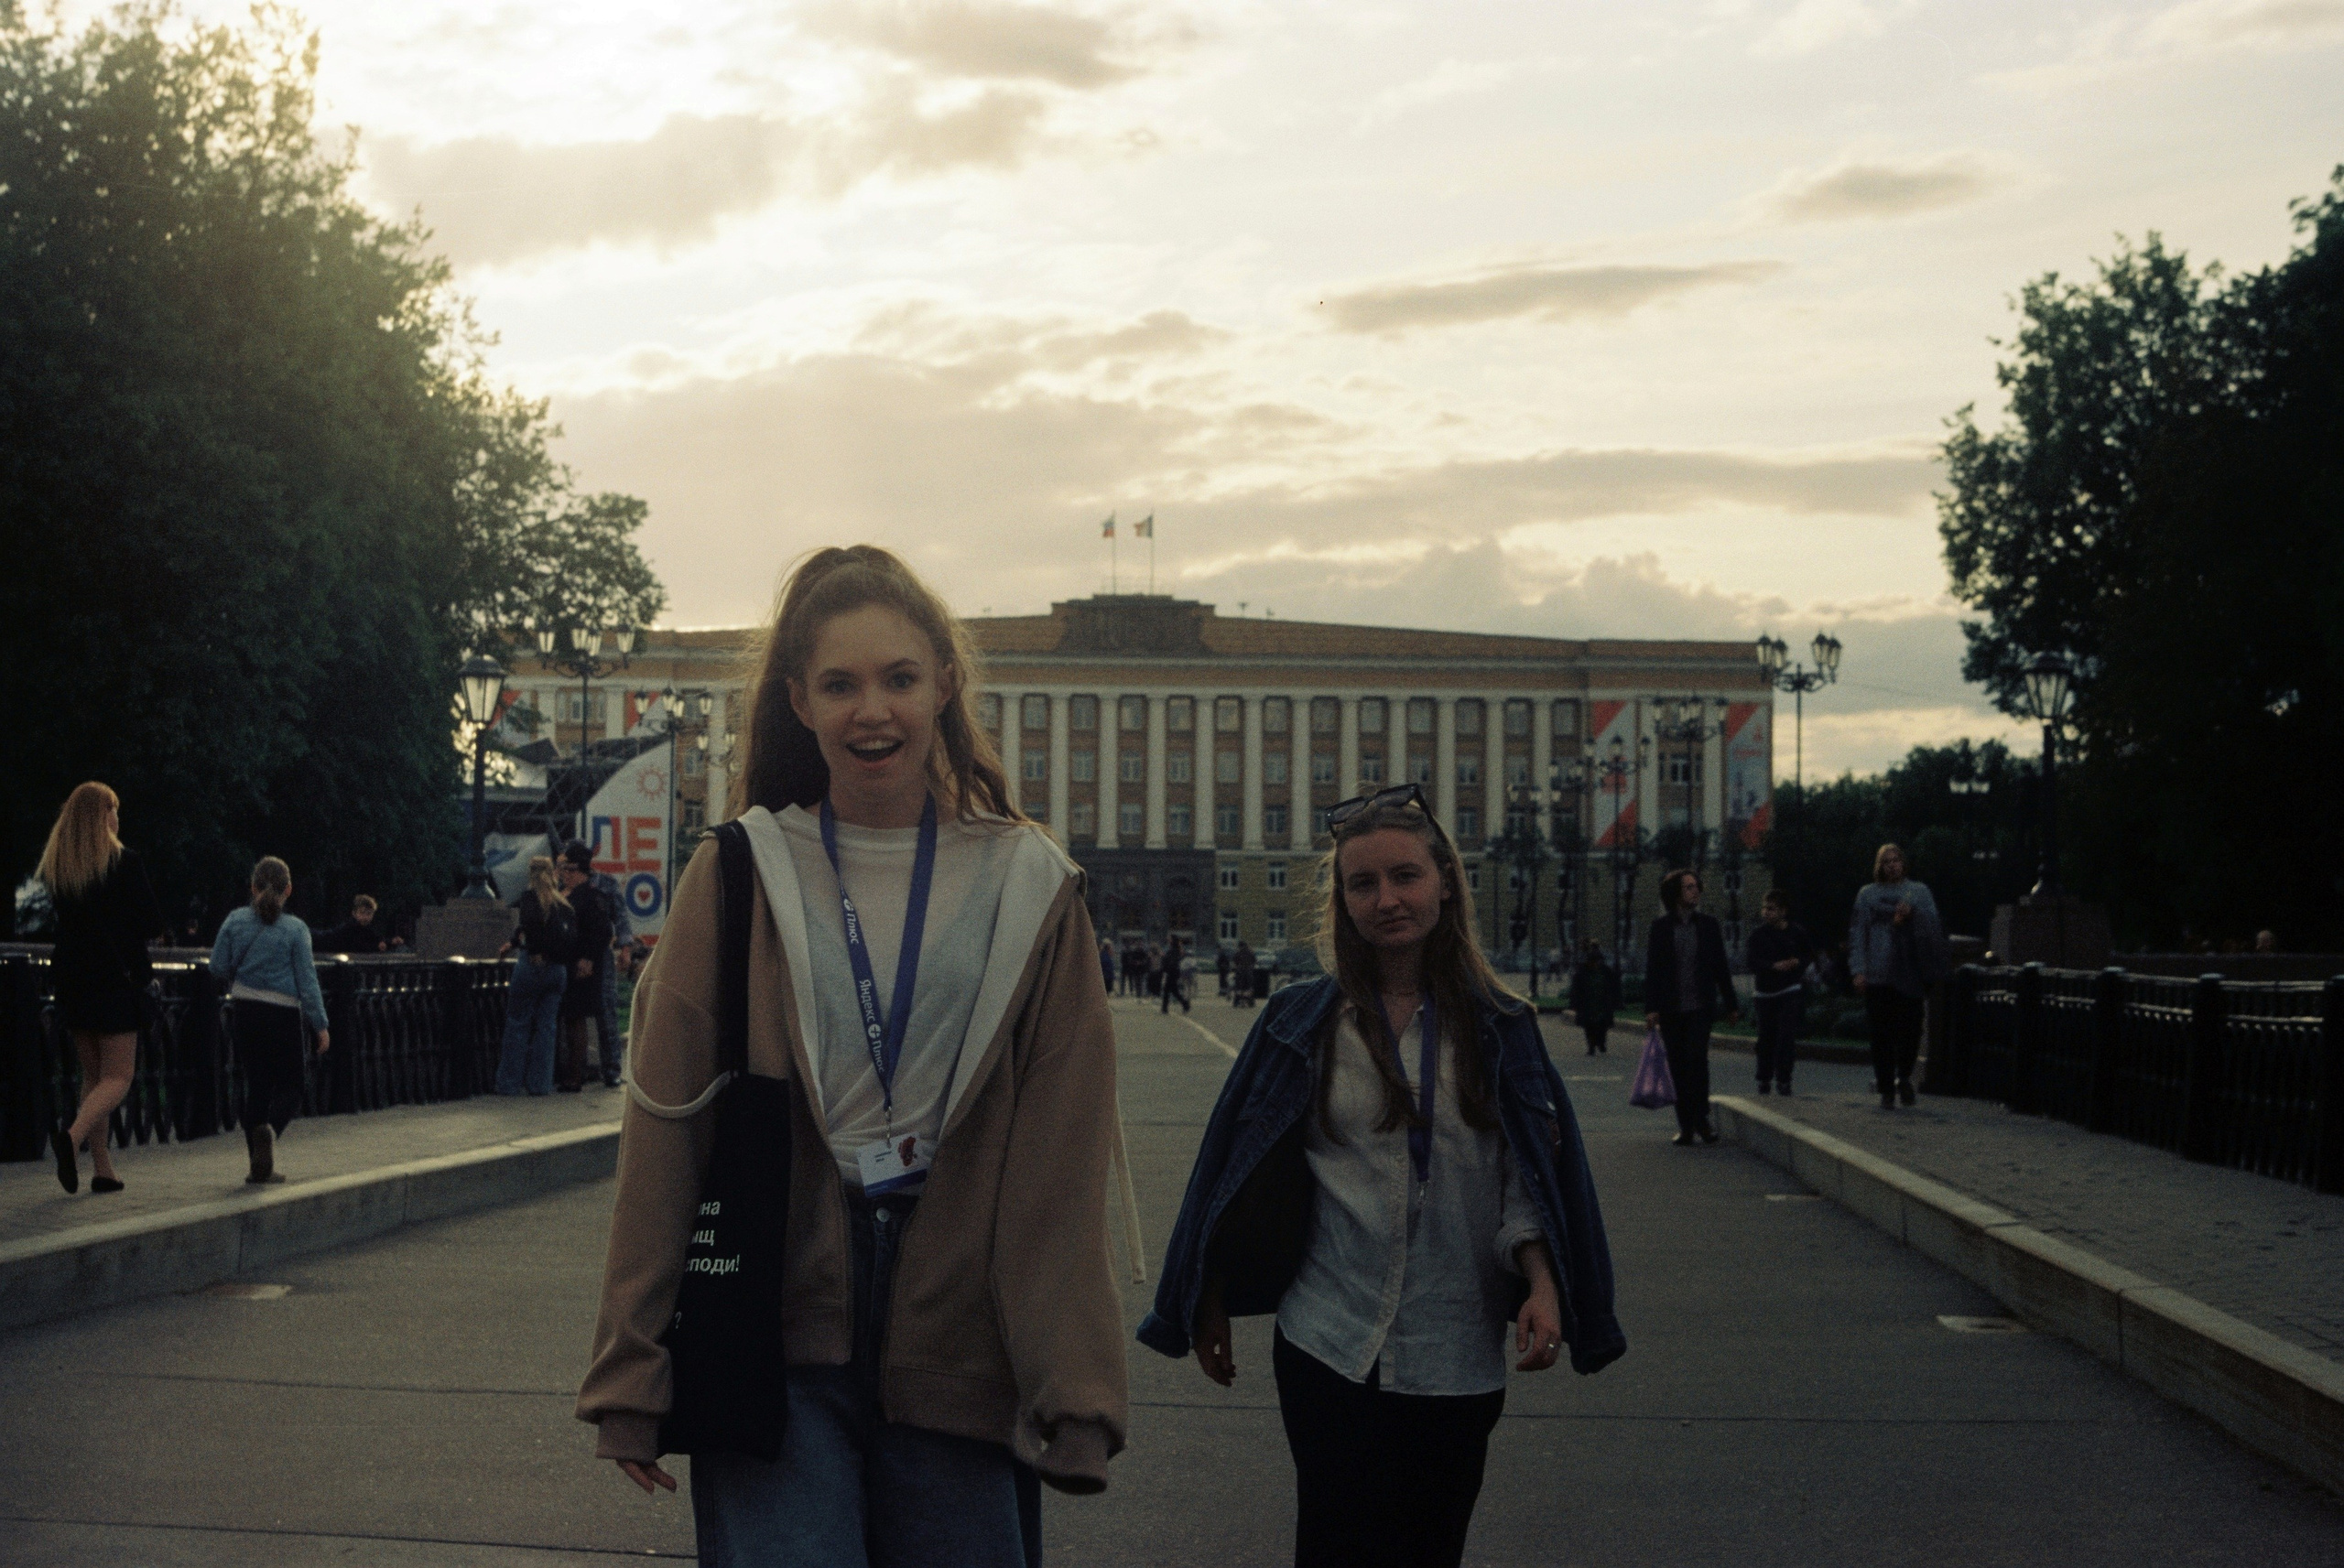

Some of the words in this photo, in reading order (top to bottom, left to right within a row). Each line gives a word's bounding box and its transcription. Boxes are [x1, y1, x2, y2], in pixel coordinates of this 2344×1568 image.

[846, 913, 860, 946] Плюс
[859, 979, 876, 1023] Яндекс
[872, 1040, 885, 1074] Плюс
[699, 1200, 722, 1216] на
